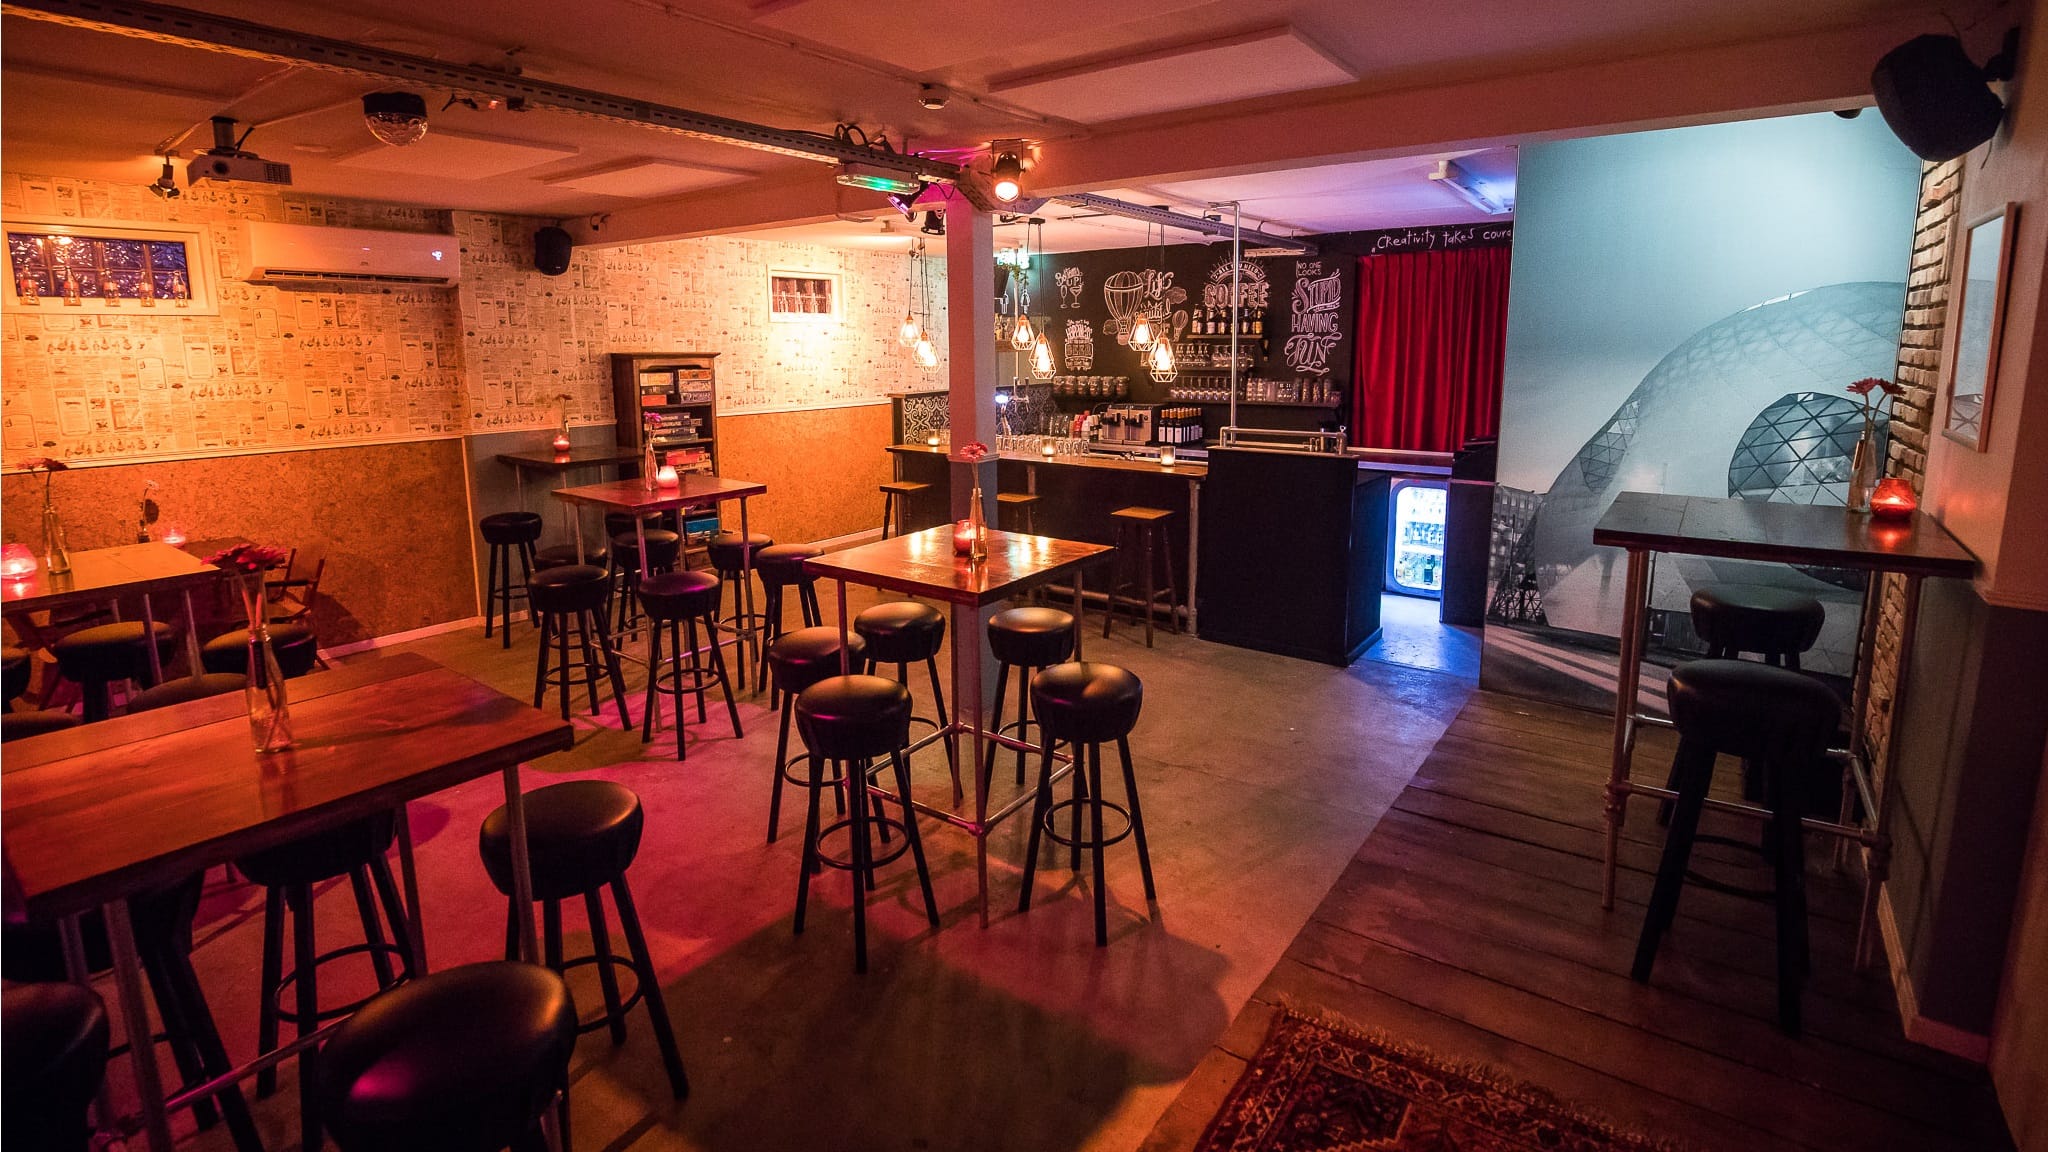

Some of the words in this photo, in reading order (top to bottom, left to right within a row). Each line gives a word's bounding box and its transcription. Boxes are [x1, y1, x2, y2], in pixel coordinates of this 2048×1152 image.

[1219, 265, 1229, 275] ALL
[1243, 263, 1259, 274] NEED
[1297, 261, 1307, 269] NO
[1297, 268, 1322, 276] LOOKS
[1291, 312, 1339, 333] HAVING
